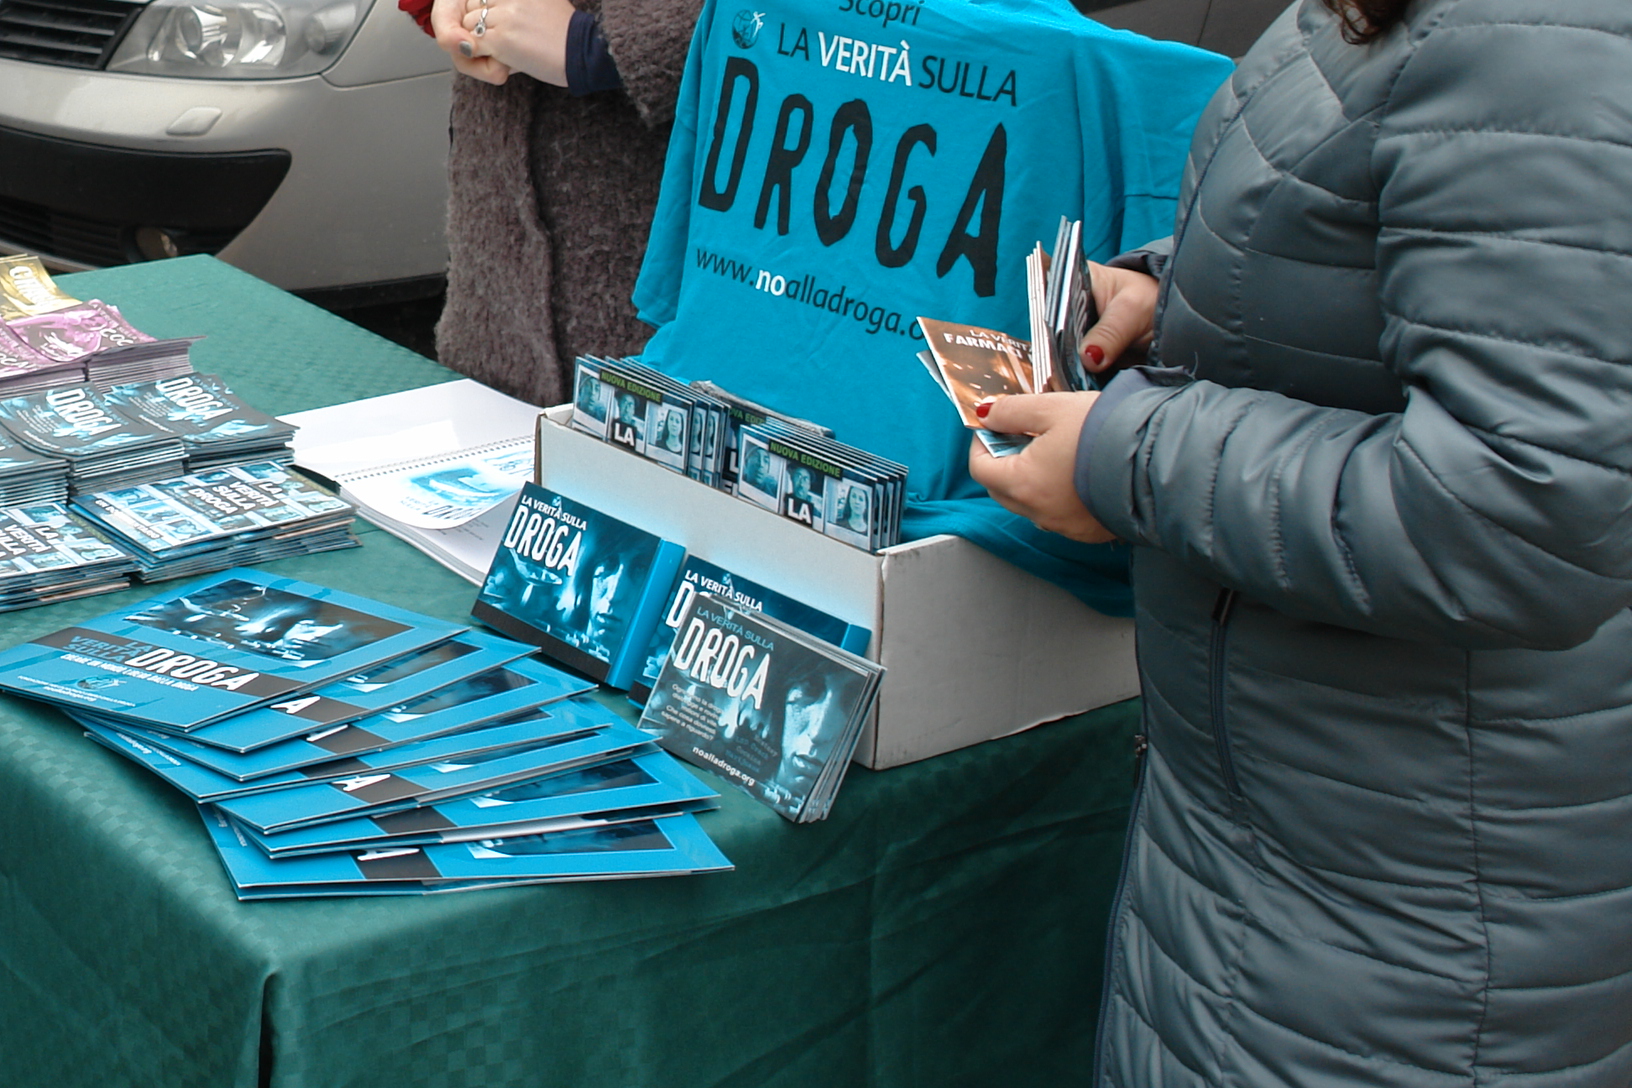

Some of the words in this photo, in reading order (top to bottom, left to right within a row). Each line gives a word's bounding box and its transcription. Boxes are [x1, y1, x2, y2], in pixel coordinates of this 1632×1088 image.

[777, 22, 809, 61] LA
[818, 31, 913, 86] VERITÀ
[919, 55, 1017, 107] SULLA
[698, 56, 1007, 298] DROGA
[697, 249, 925, 340] www.noalladroga.o
[969, 330, 990, 339] LA
[990, 333, 1032, 352] VERIT
[601, 371, 626, 389] NUOVA
[46, 388, 121, 436] DROGA
[155, 377, 233, 420] DROGA
[614, 422, 635, 446] LA
[730, 451, 739, 471] L
[770, 441, 799, 461] NUOVA
[801, 454, 841, 478] EDIZIONE
[188, 487, 240, 515] DROGA
[212, 485, 257, 511] SULLA
[259, 481, 283, 495] LA
[521, 495, 532, 507] LA
[533, 500, 561, 519] VERITÀ
[561, 512, 587, 531] SULLA
[788, 497, 812, 524] LA
[35, 525, 59, 540] LA
[504, 505, 582, 576] DROGA
[685, 570, 699, 583] LA
[700, 576, 734, 600] VERITÀ
[734, 592, 763, 612] SULLA
[697, 606, 710, 620] LA
[711, 615, 744, 635] VERITÀ
[744, 630, 774, 651] SULLA
[63, 643, 126, 662] SULLA
[125, 642, 152, 652] LA
[673, 617, 770, 710] DROGA
[124, 648, 259, 691] DROGA
[692, 746, 756, 787] noalladroga.org
